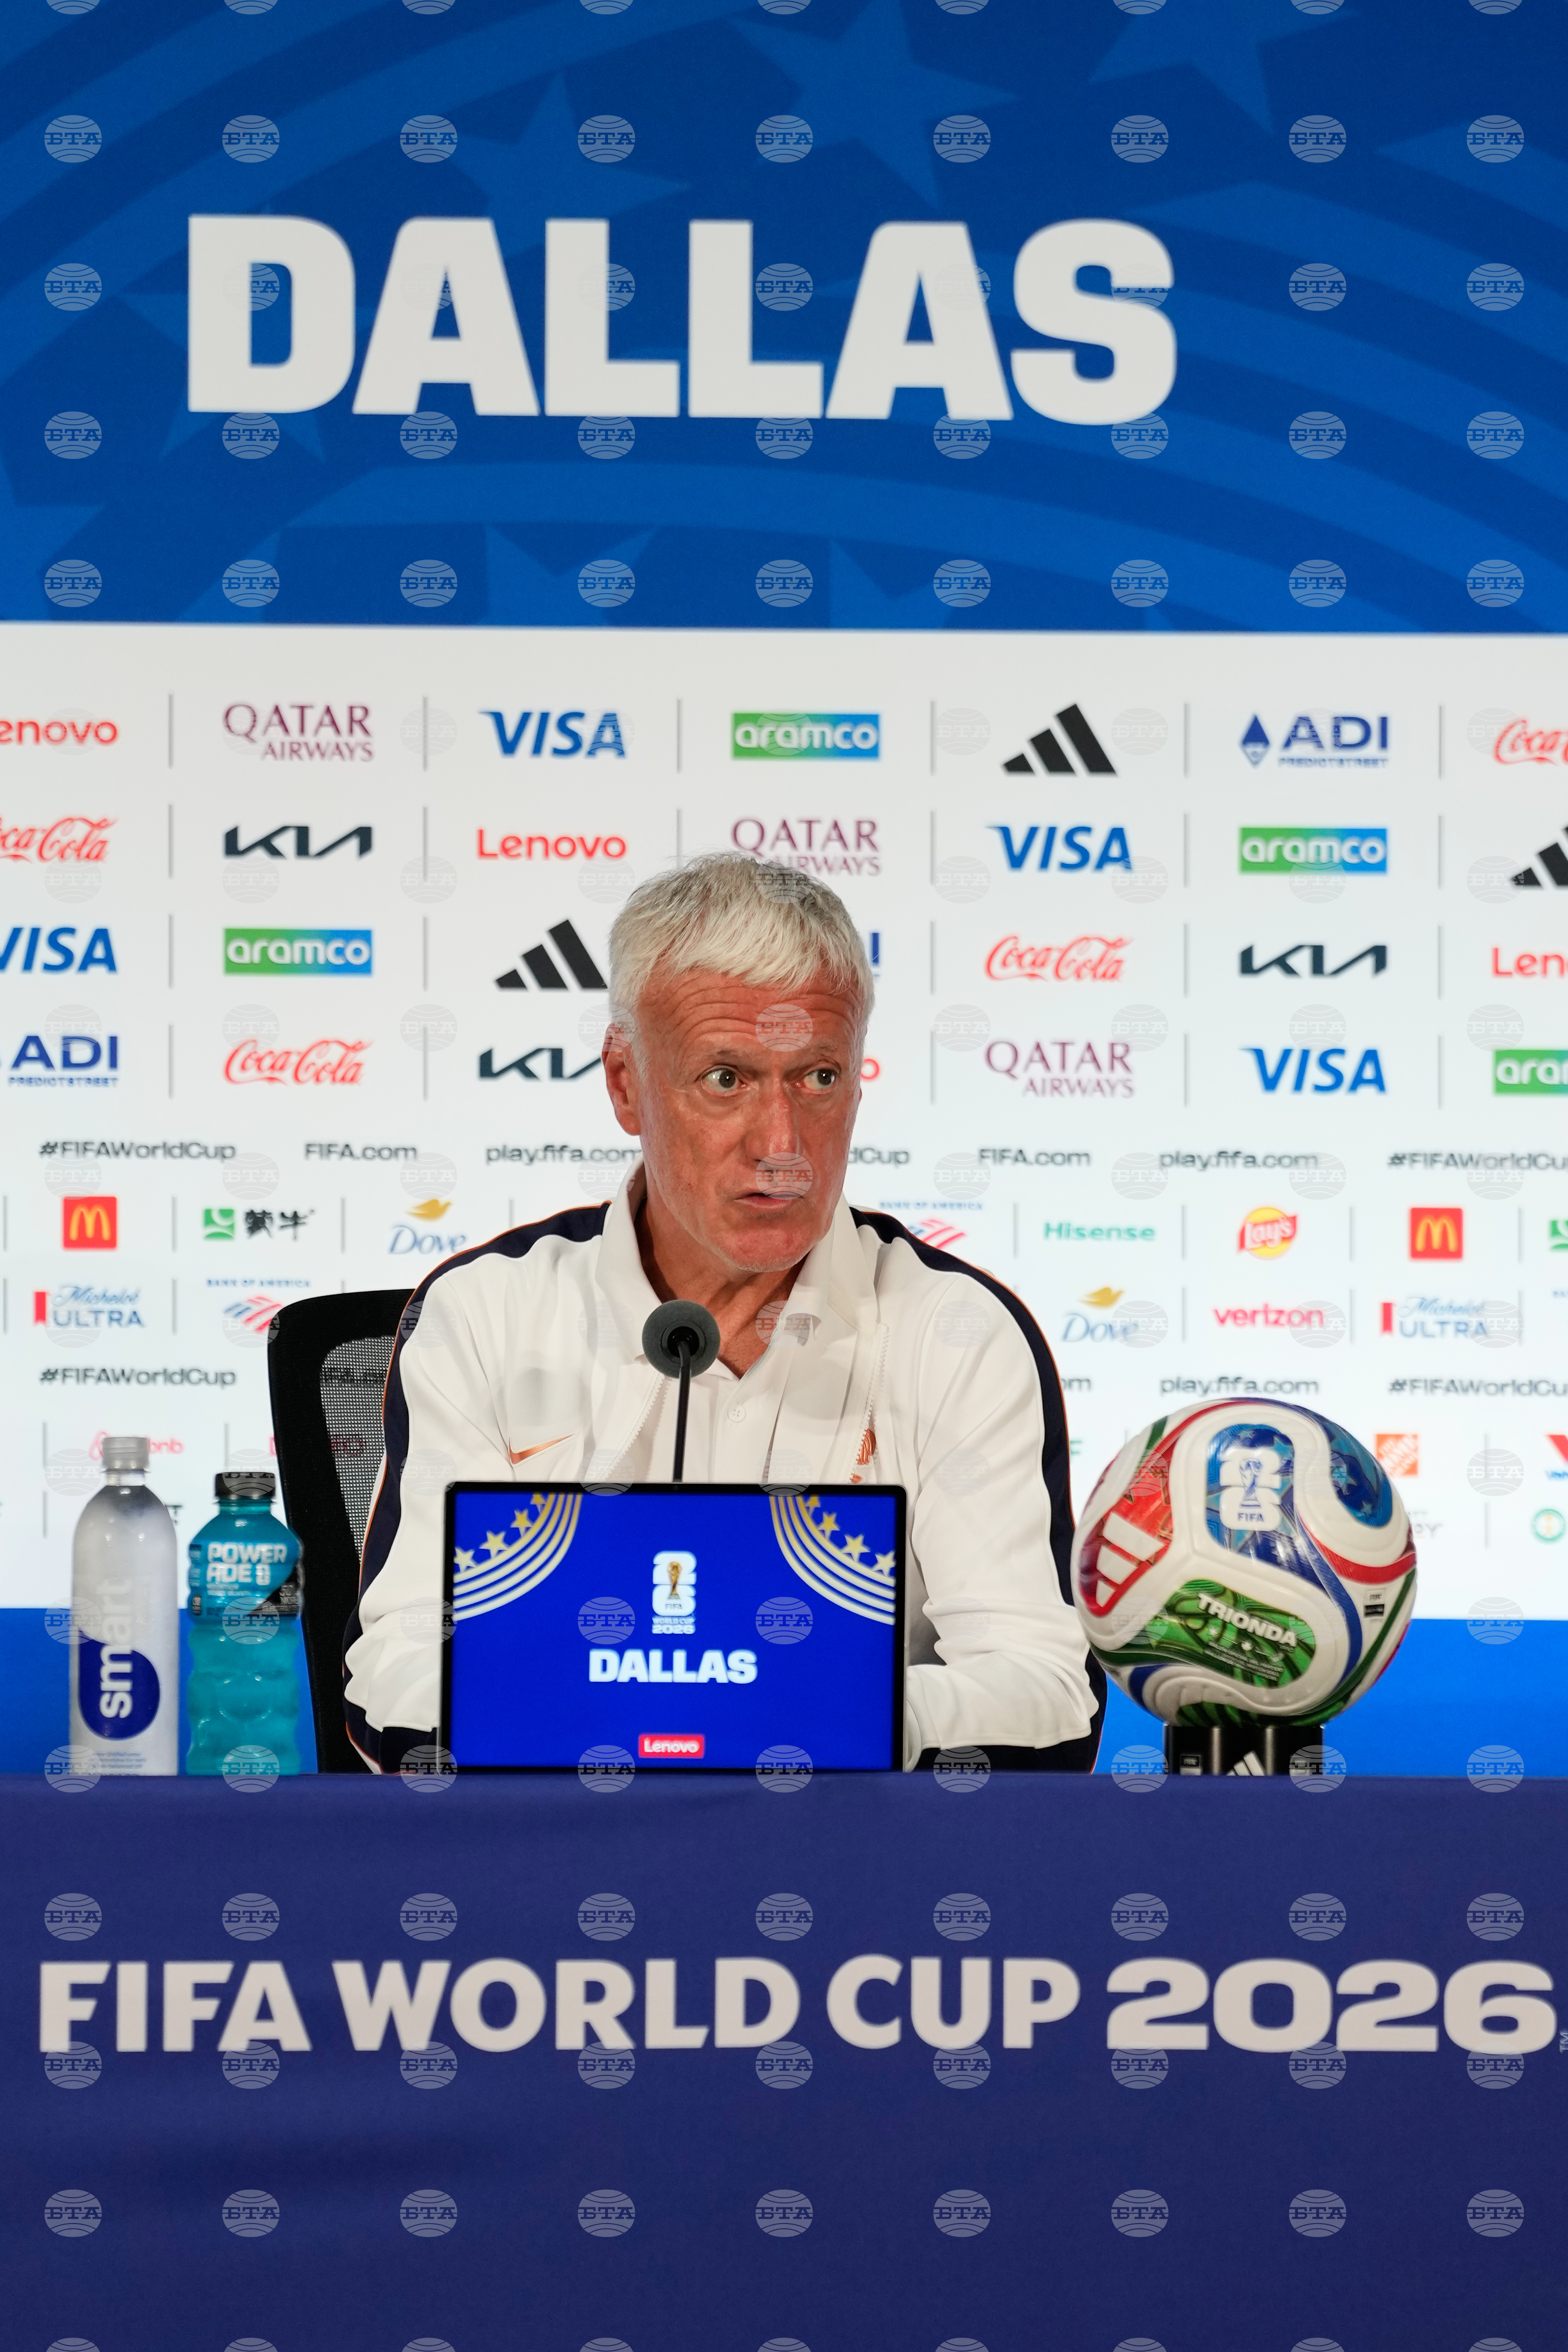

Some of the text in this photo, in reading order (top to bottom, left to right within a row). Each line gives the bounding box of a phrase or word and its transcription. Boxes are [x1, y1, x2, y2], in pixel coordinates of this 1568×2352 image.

[188, 214, 1177, 426] DALLAS
[223, 704, 372, 743] QATAR
[478, 711, 626, 758] VISA
[735, 722, 878, 750] aramco
[1283, 716, 1388, 750] ADI
[262, 742, 374, 762] AIRWAYS
[224, 825, 373, 858] KIA
[477, 828, 627, 860] Lenovo
[731, 818, 879, 855] QATAR
[988, 826, 1132, 872] VISA
[1242, 836, 1385, 864] aramco
[226, 938, 370, 966] aramco
[1239, 944, 1387, 976] KIA
[11, 1035, 118, 1070] ADI
[985, 1041, 1132, 1079] QATAR
[1241, 1048, 1386, 1093] VISA
[1024, 1078, 1134, 1097] AIRWAYS
[39, 1141, 236, 1162] #FIFAWorldCup
[305, 1142, 418, 1161] FIFA.com
[978, 1147, 1091, 1166] FIFA.com
[1159, 1150, 1319, 1172] play.fifa.com
[1388, 1152, 1568, 1170] #FIFAWorldCu
[389, 1224, 467, 1255] Dove
[1044, 1222, 1156, 1241] Hisense
[53, 1308, 145, 1328] ULTRA
[1062, 1312, 1139, 1343] Dove
[1213, 1303, 1325, 1327] verizon
[1399, 1319, 1490, 1338] ULTRA
[39, 1367, 236, 1388] #FIFAWorldCup
[1160, 1376, 1319, 1397] play.fifa.com
[1389, 1378, 1568, 1397] #FIFAWorldCu
[1238, 1512, 1264, 1523] FIFA
[207, 1541, 287, 1564] POWER
[206, 1563, 252, 1583] ADE
[652, 1623, 696, 1634] 2026
[1198, 1592, 1297, 1648] TRIONDA
[589, 1649, 757, 1684] DALLAS
[643, 1738, 700, 1753] Lenovo
[39, 1953, 1558, 2055] FIFA WORLD CUP 2026
